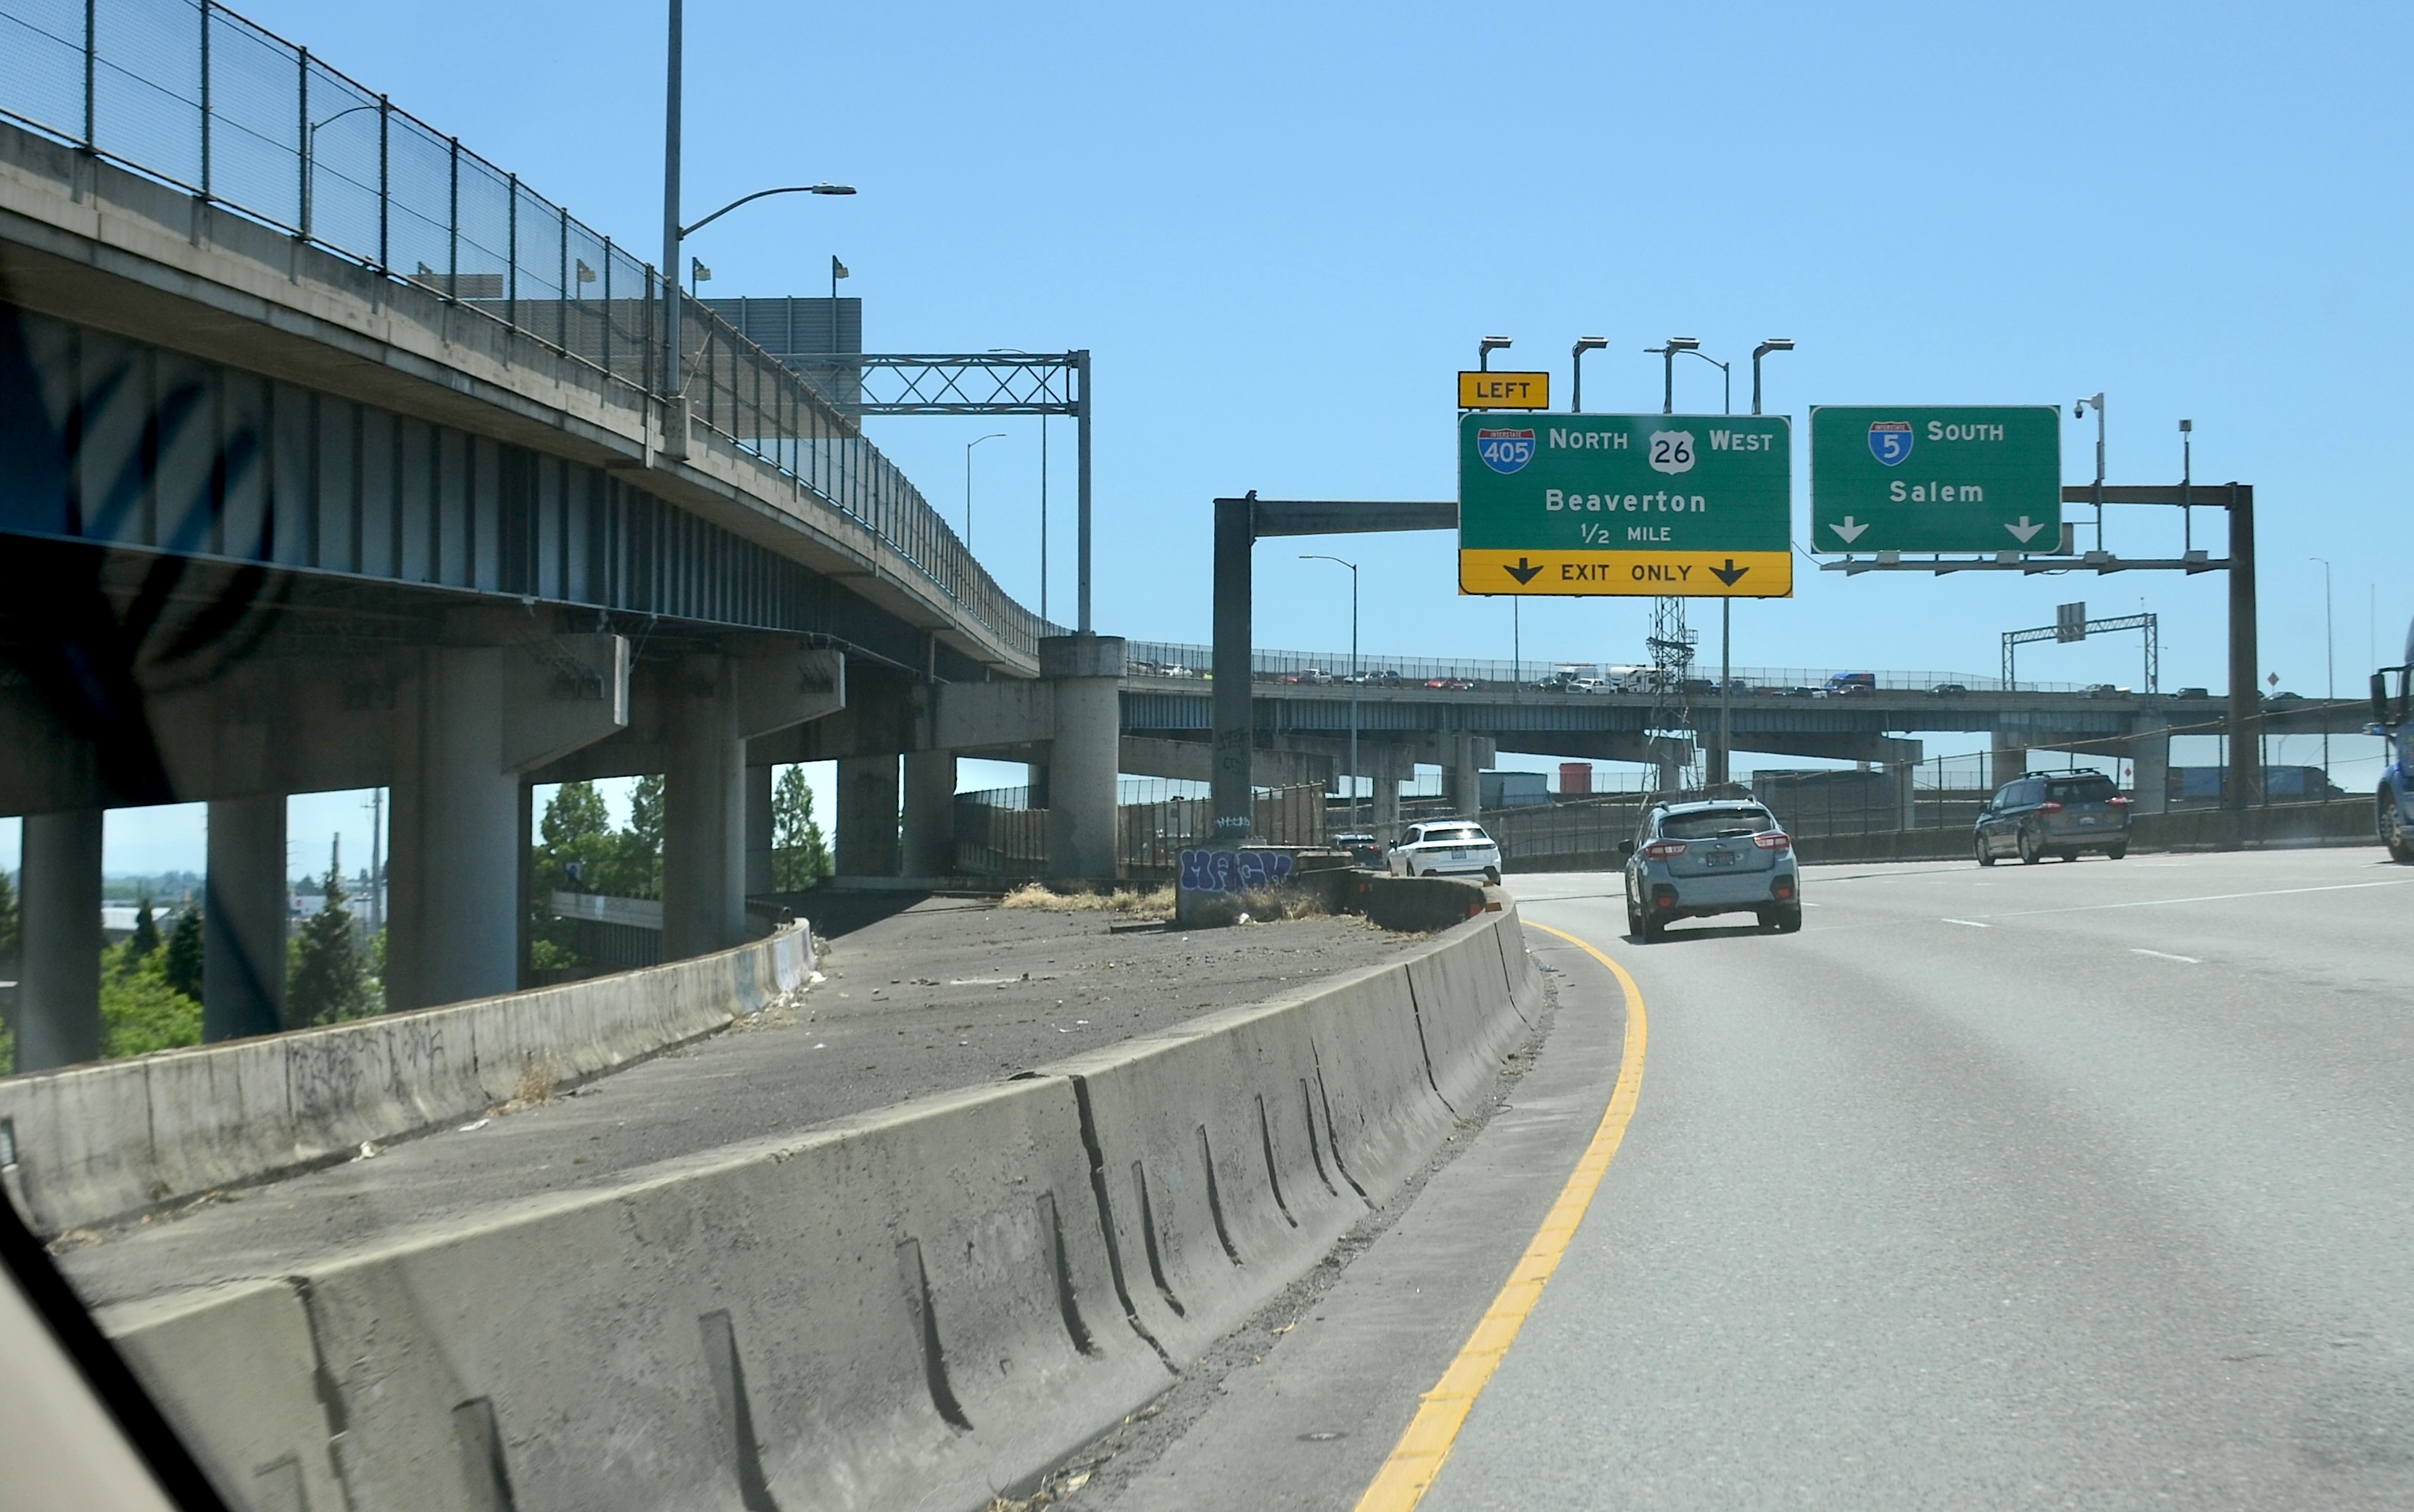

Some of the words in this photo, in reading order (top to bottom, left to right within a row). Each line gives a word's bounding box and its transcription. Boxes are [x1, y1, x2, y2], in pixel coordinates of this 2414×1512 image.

[1477, 382, 1530, 399] LEFT
[1484, 442, 1530, 462] 405
[1549, 428, 1628, 449] NORTH
[1654, 440, 1690, 463] 26
[1709, 430, 1773, 451] WEST
[1884, 434, 1900, 458] 5
[1927, 420, 2004, 441] SOUTH
[1546, 489, 1705, 512] Beaverton
[1889, 480, 1983, 502] Salem
[1627, 527, 1671, 541] MILE
[1561, 564, 1609, 581] EXIT
[1631, 565, 1692, 581] ONLY
